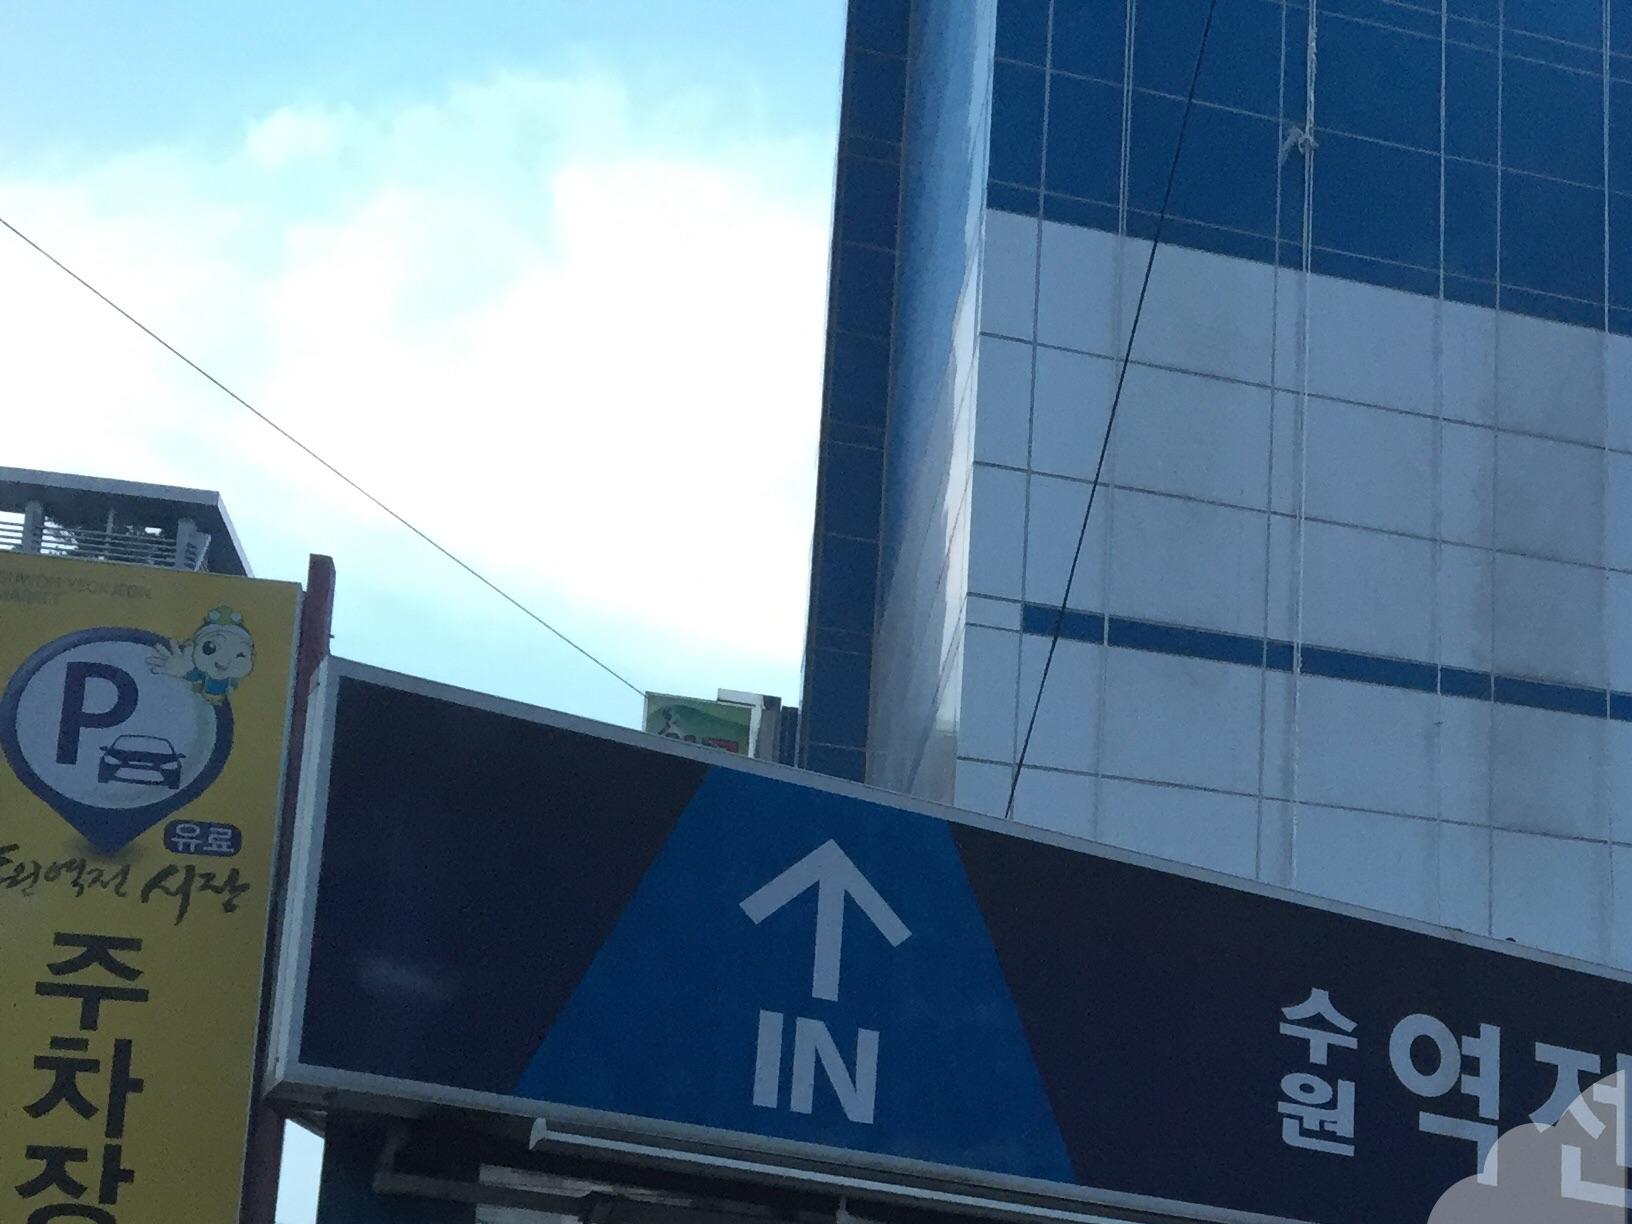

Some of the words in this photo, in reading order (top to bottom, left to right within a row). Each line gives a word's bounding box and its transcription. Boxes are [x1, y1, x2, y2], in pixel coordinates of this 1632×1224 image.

[172, 823, 234, 853] 유료
[752, 1009, 880, 1125] IN
[1277, 987, 1358, 1158] 수원
